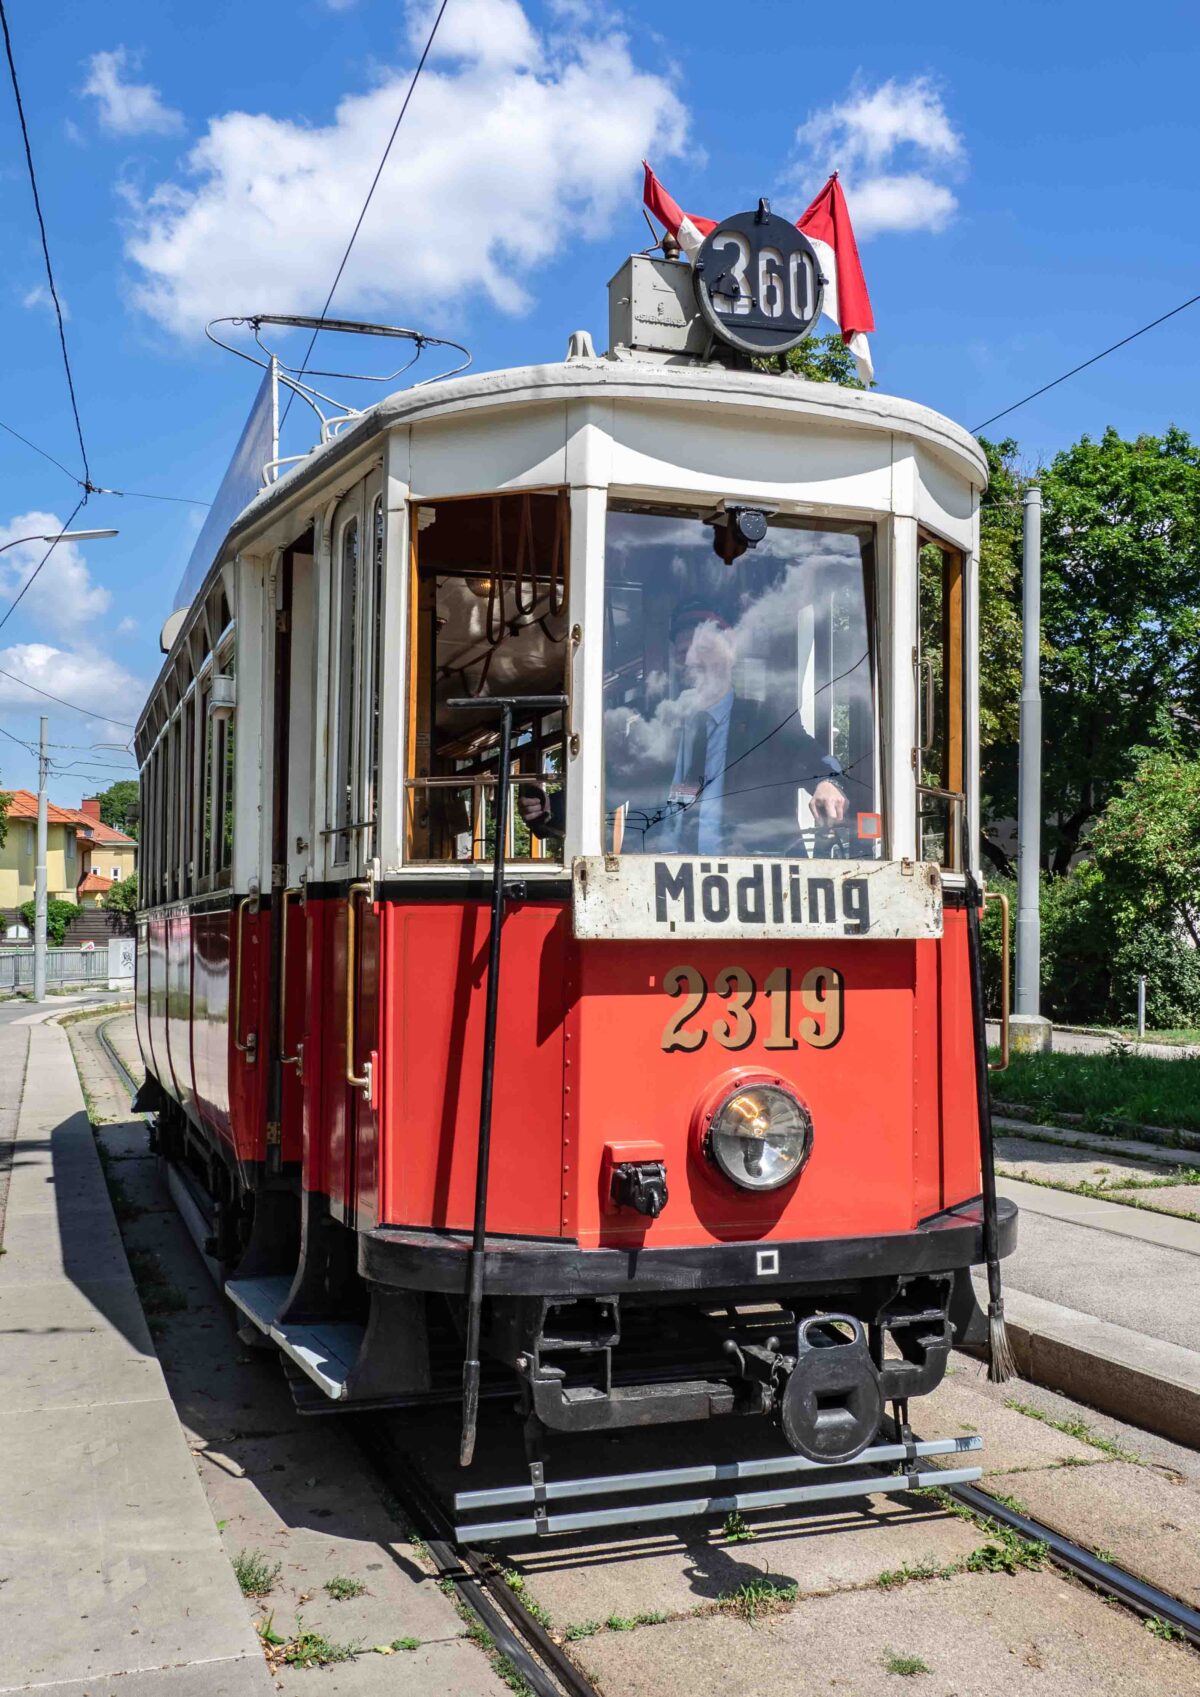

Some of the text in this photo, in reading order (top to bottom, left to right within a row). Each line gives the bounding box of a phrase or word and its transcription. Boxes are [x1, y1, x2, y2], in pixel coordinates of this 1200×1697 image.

[712, 229, 814, 321] 360
[654, 861, 870, 934] Mödling
[661, 964, 845, 1053] 2319
